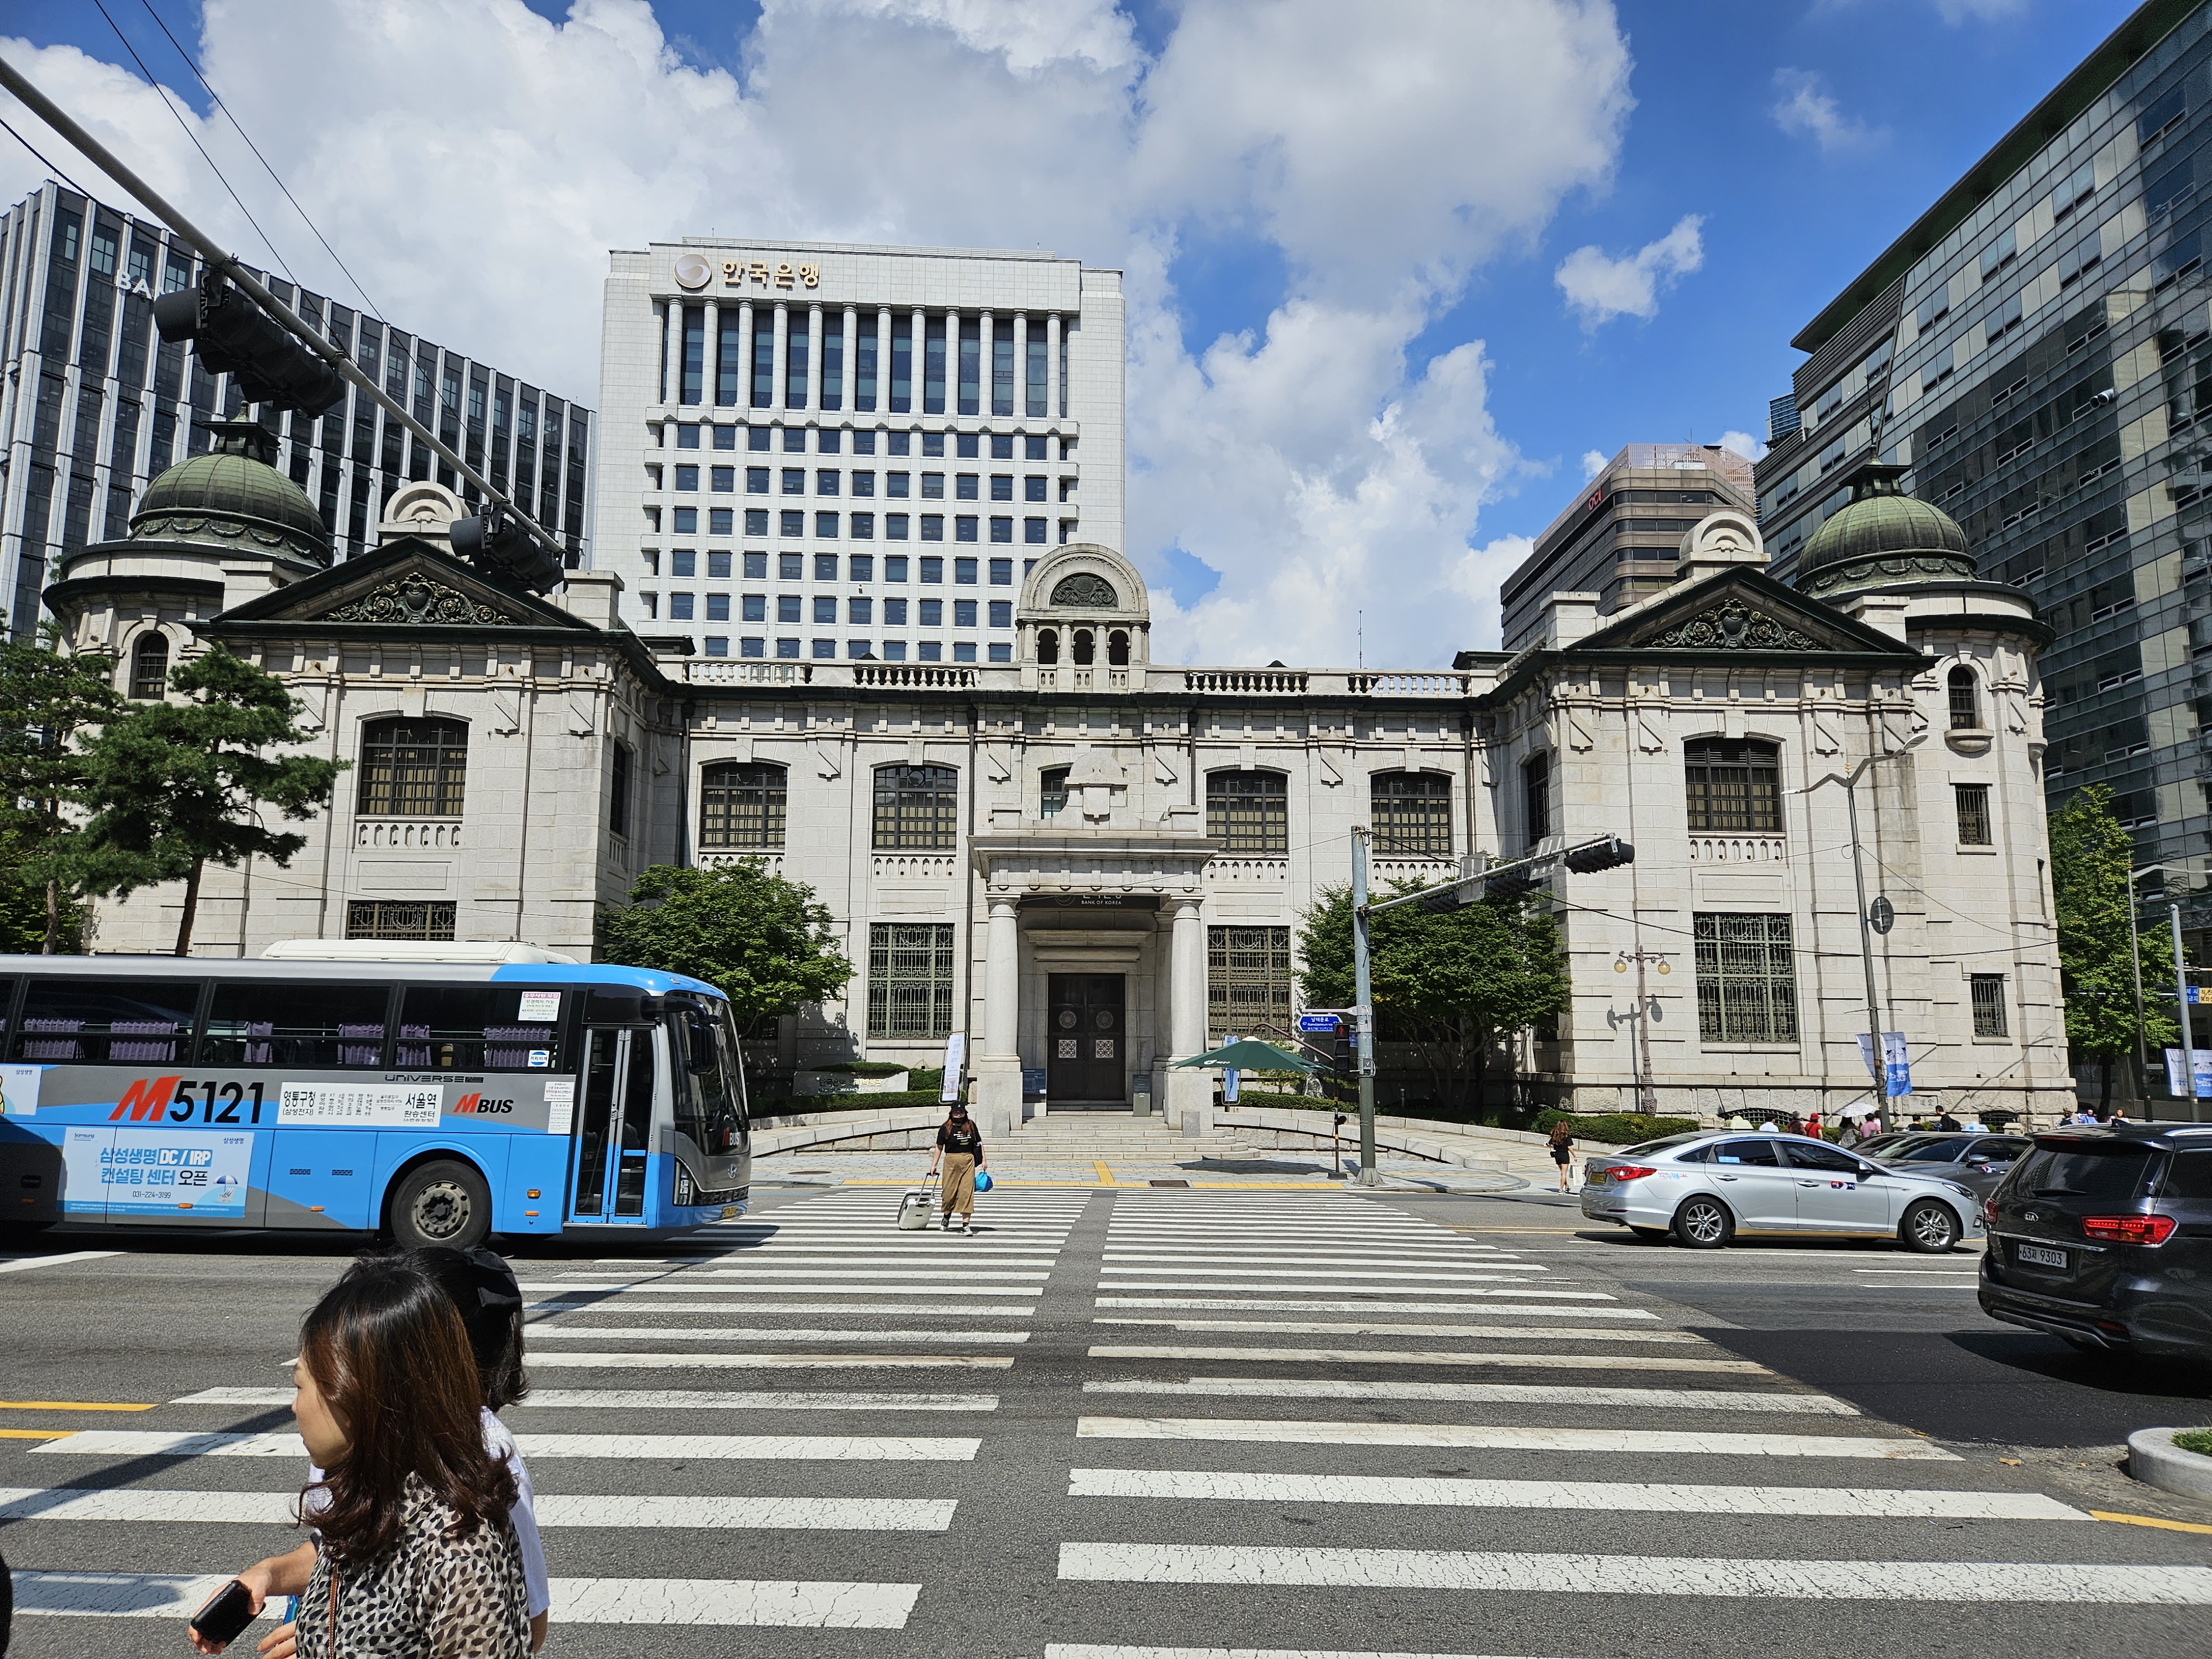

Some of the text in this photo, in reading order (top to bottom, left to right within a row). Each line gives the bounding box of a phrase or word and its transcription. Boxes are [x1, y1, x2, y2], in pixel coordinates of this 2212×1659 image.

[722, 260, 820, 287] 한국은행
[284, 1091, 316, 1108] 영통구청
[405, 1093, 437, 1109] 서울역
[100, 1147, 158, 1165] 삼성생명
[159, 1149, 179, 1165] DC
[189, 1150, 211, 1166] IRP
[101, 1168, 208, 1186] 컨설팅 센터 오픈
[132, 1191, 171, 1199] 031-224-3199
[2041, 1250, 2062, 1265] 9303
